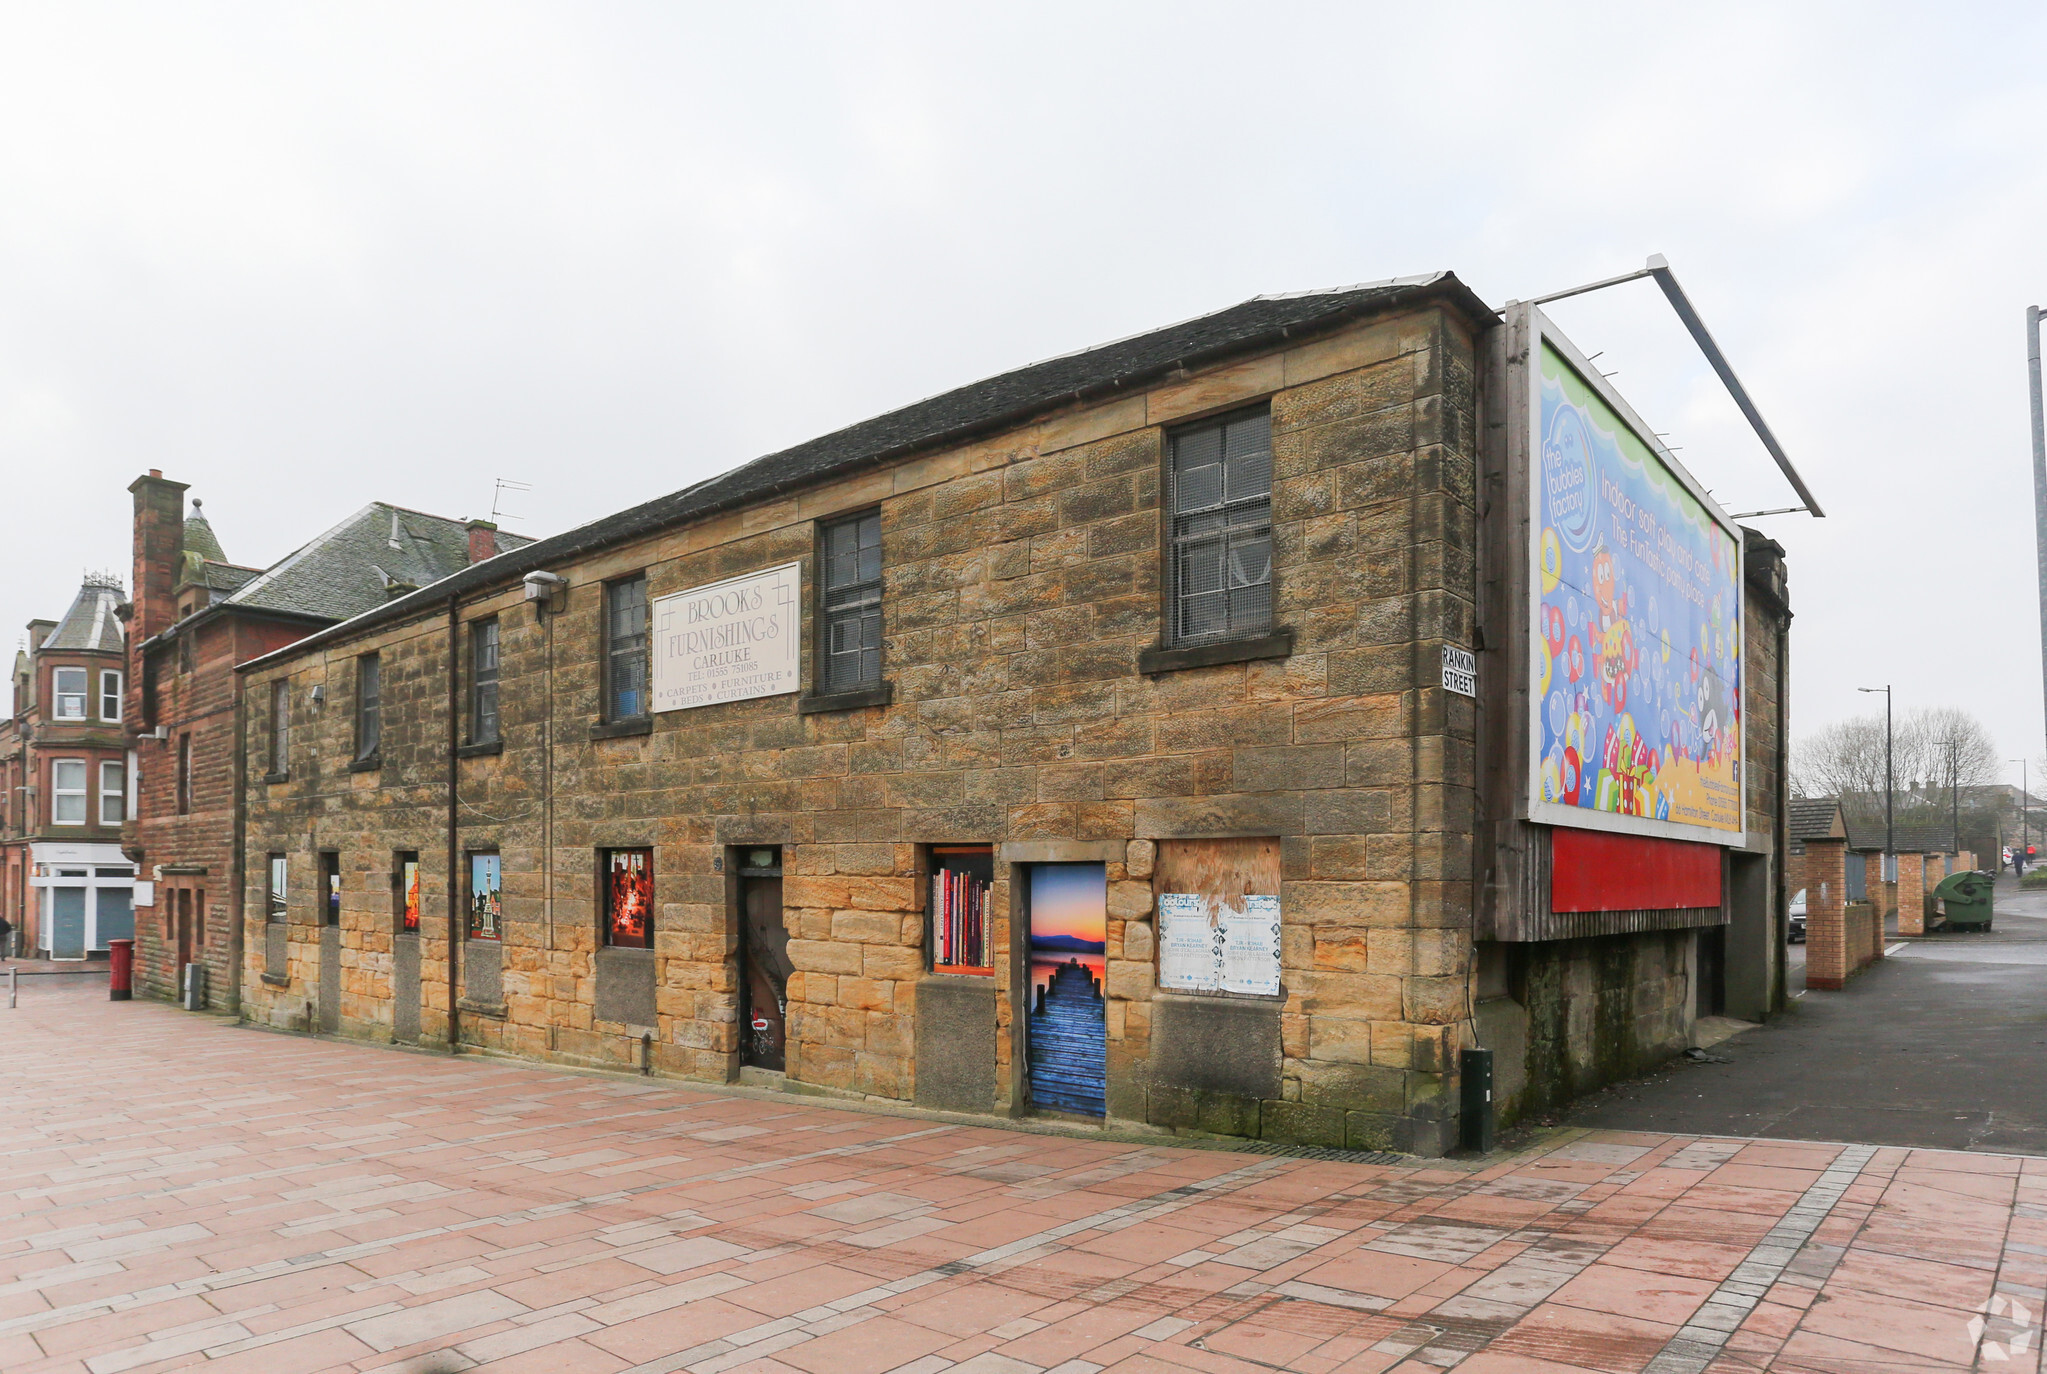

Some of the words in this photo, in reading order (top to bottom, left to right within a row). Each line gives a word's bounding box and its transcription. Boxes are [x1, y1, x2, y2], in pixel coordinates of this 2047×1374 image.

[1546, 447, 1561, 470] the
[1550, 463, 1584, 495] bubbles
[1553, 490, 1583, 518] factory
[1602, 468, 1636, 521] Indoor
[1639, 509, 1656, 539] soft
[1658, 524, 1677, 559] play
[1678, 545, 1693, 572] and
[1611, 513, 1628, 548] The
[1630, 529, 1665, 577] FunTastic
[1667, 566, 1685, 593] party
[1686, 581, 1705, 608] place
[688, 585, 763, 624] BROOKS
[669, 614, 779, 658] FURNISHINGS
[688, 669, 705, 682] TEL:
[706, 666, 728, 679] 01555
[732, 661, 758, 674] 751085
[693, 647, 750, 670] CARLUKE
[1443, 647, 1474, 672] RANKIN
[666, 683, 708, 698] CARPETS
[721, 671, 782, 689] FURNITURE
[681, 694, 704, 706] BEDS
[717, 685, 766, 700] CURTAINS
[1444, 670, 1473, 694] STREET
